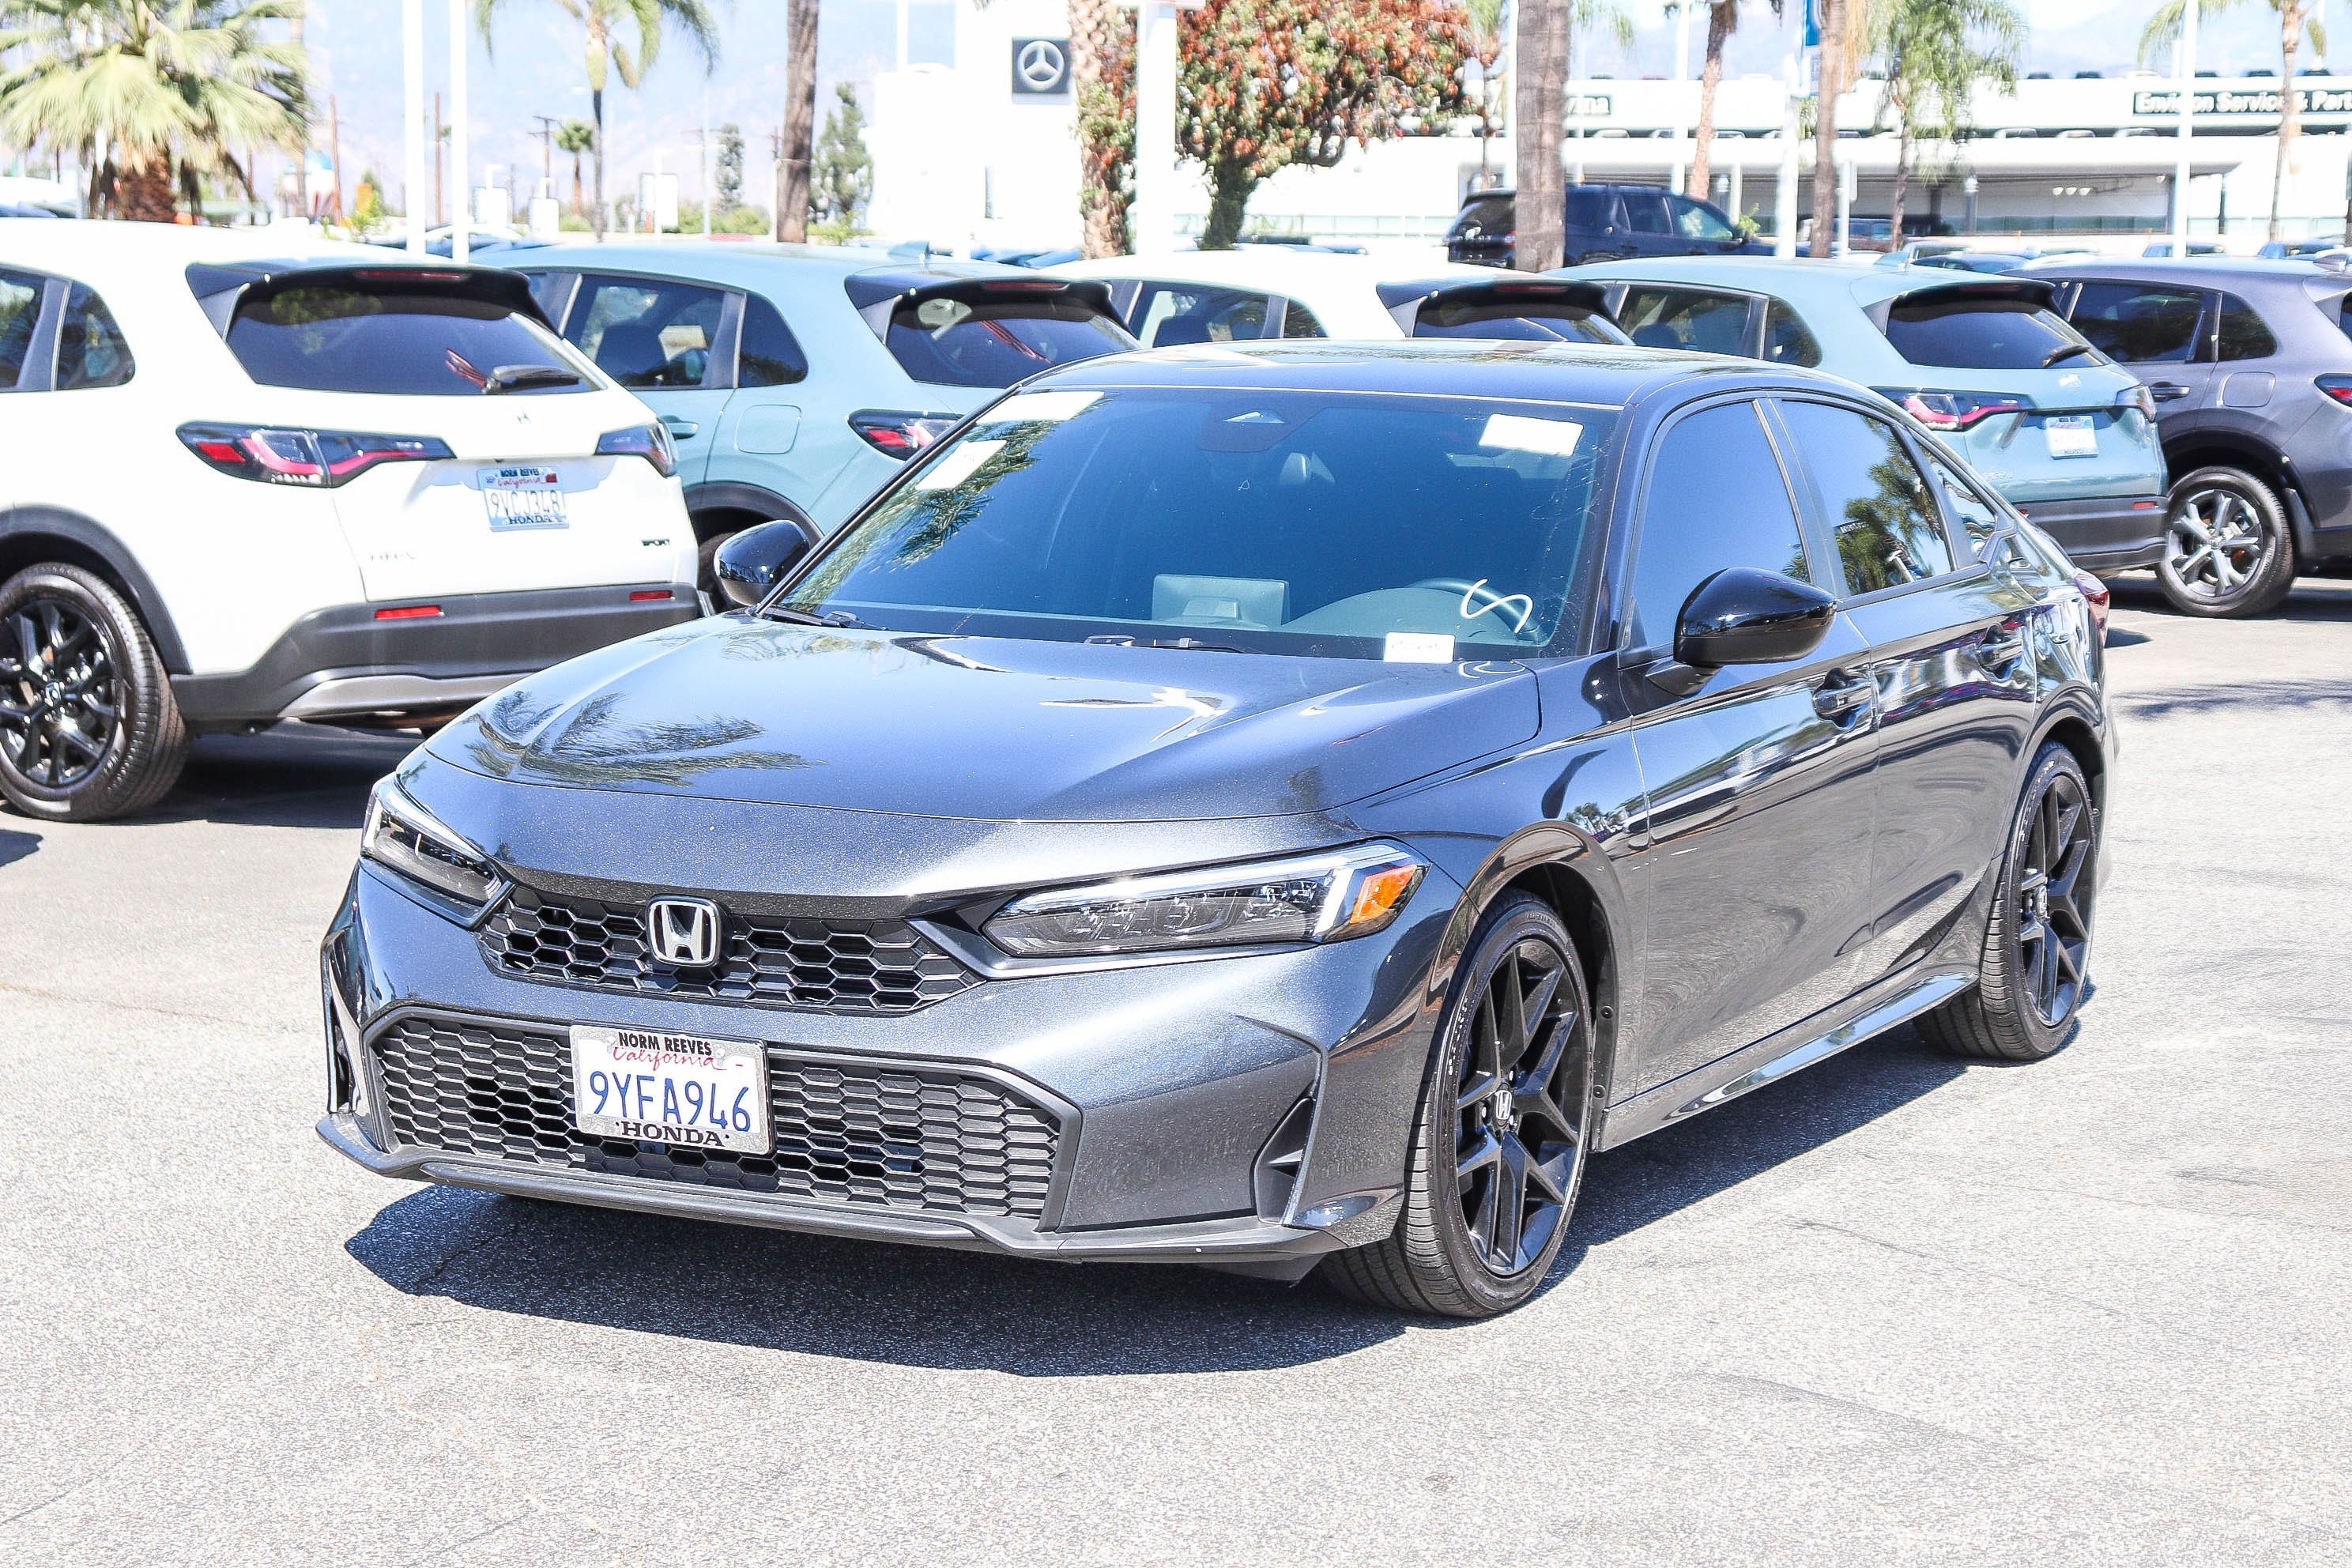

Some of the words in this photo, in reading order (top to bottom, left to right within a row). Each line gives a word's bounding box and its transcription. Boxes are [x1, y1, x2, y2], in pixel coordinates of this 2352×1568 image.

[2135, 92, 2214, 113] Envion
[618, 1031, 660, 1050] NORM
[665, 1036, 712, 1056] REEVES
[612, 1046, 727, 1071] California
[590, 1070, 751, 1133] 9YFA946
[621, 1120, 726, 1147] HONDA
